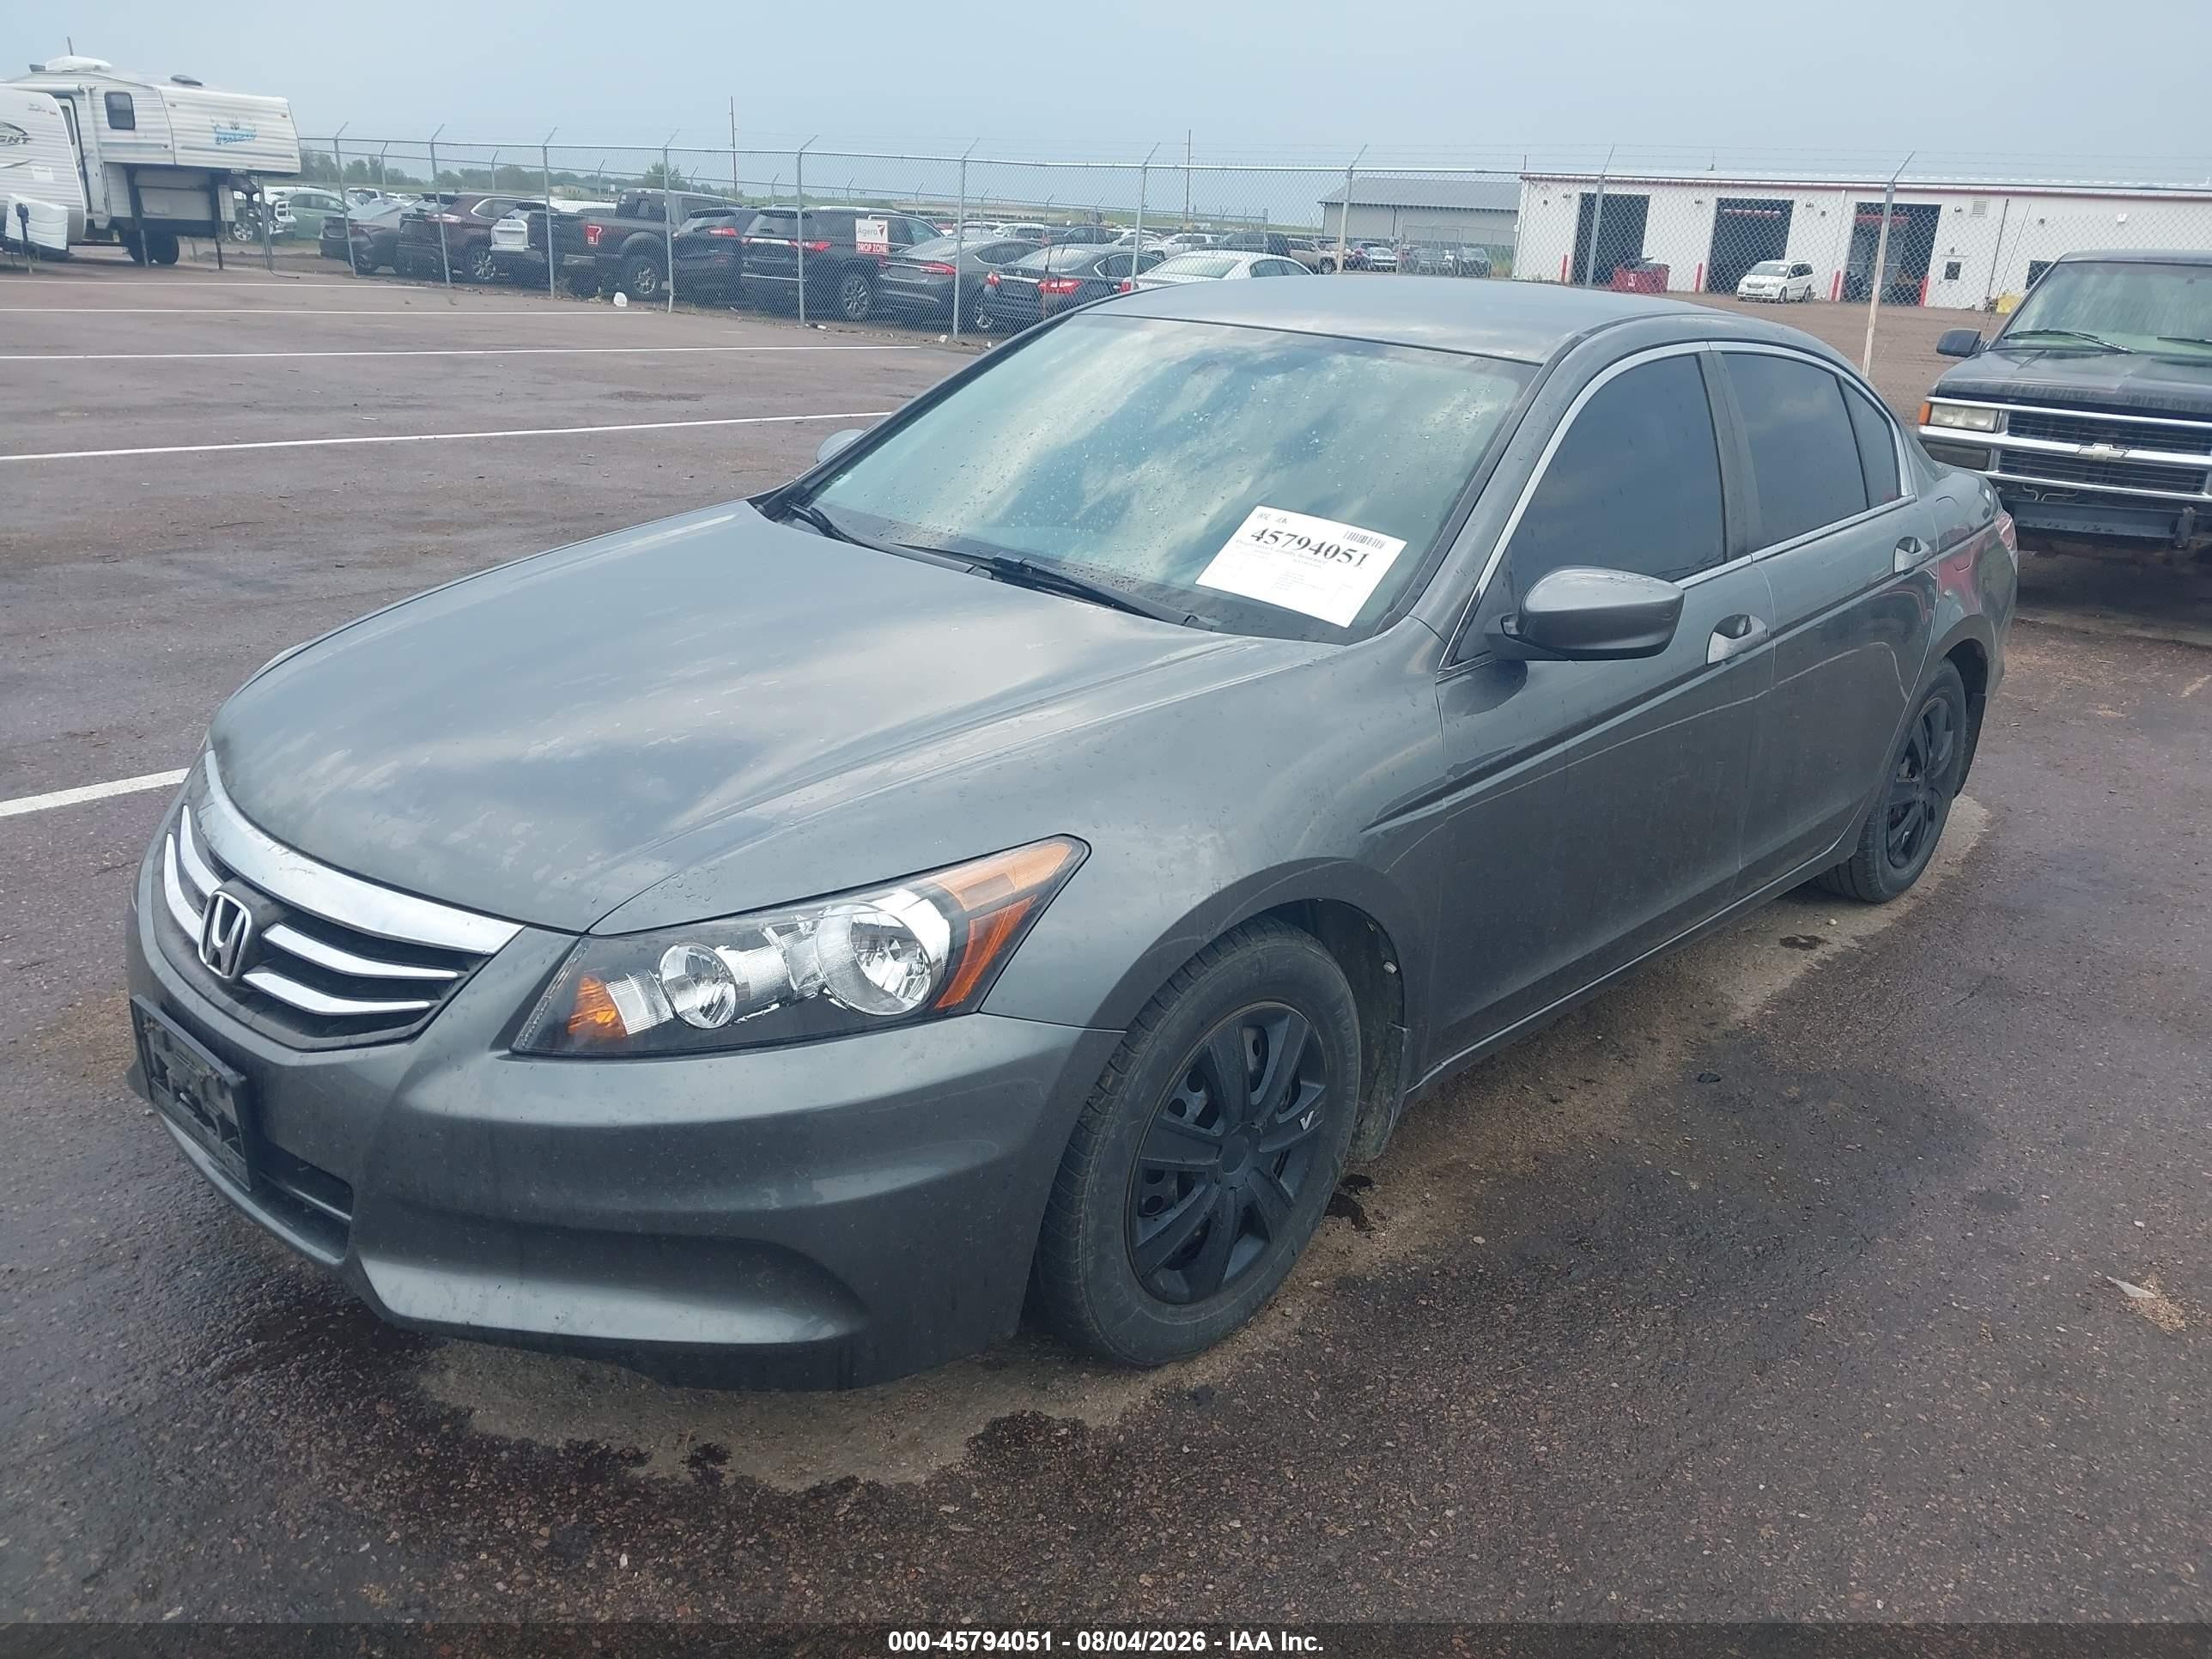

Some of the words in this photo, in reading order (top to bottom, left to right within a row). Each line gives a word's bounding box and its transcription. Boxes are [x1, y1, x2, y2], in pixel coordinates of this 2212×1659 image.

[857, 242, 871, 252] DROP
[872, 244, 888, 253] ZONE
[1250, 528, 1370, 568] 45794051
